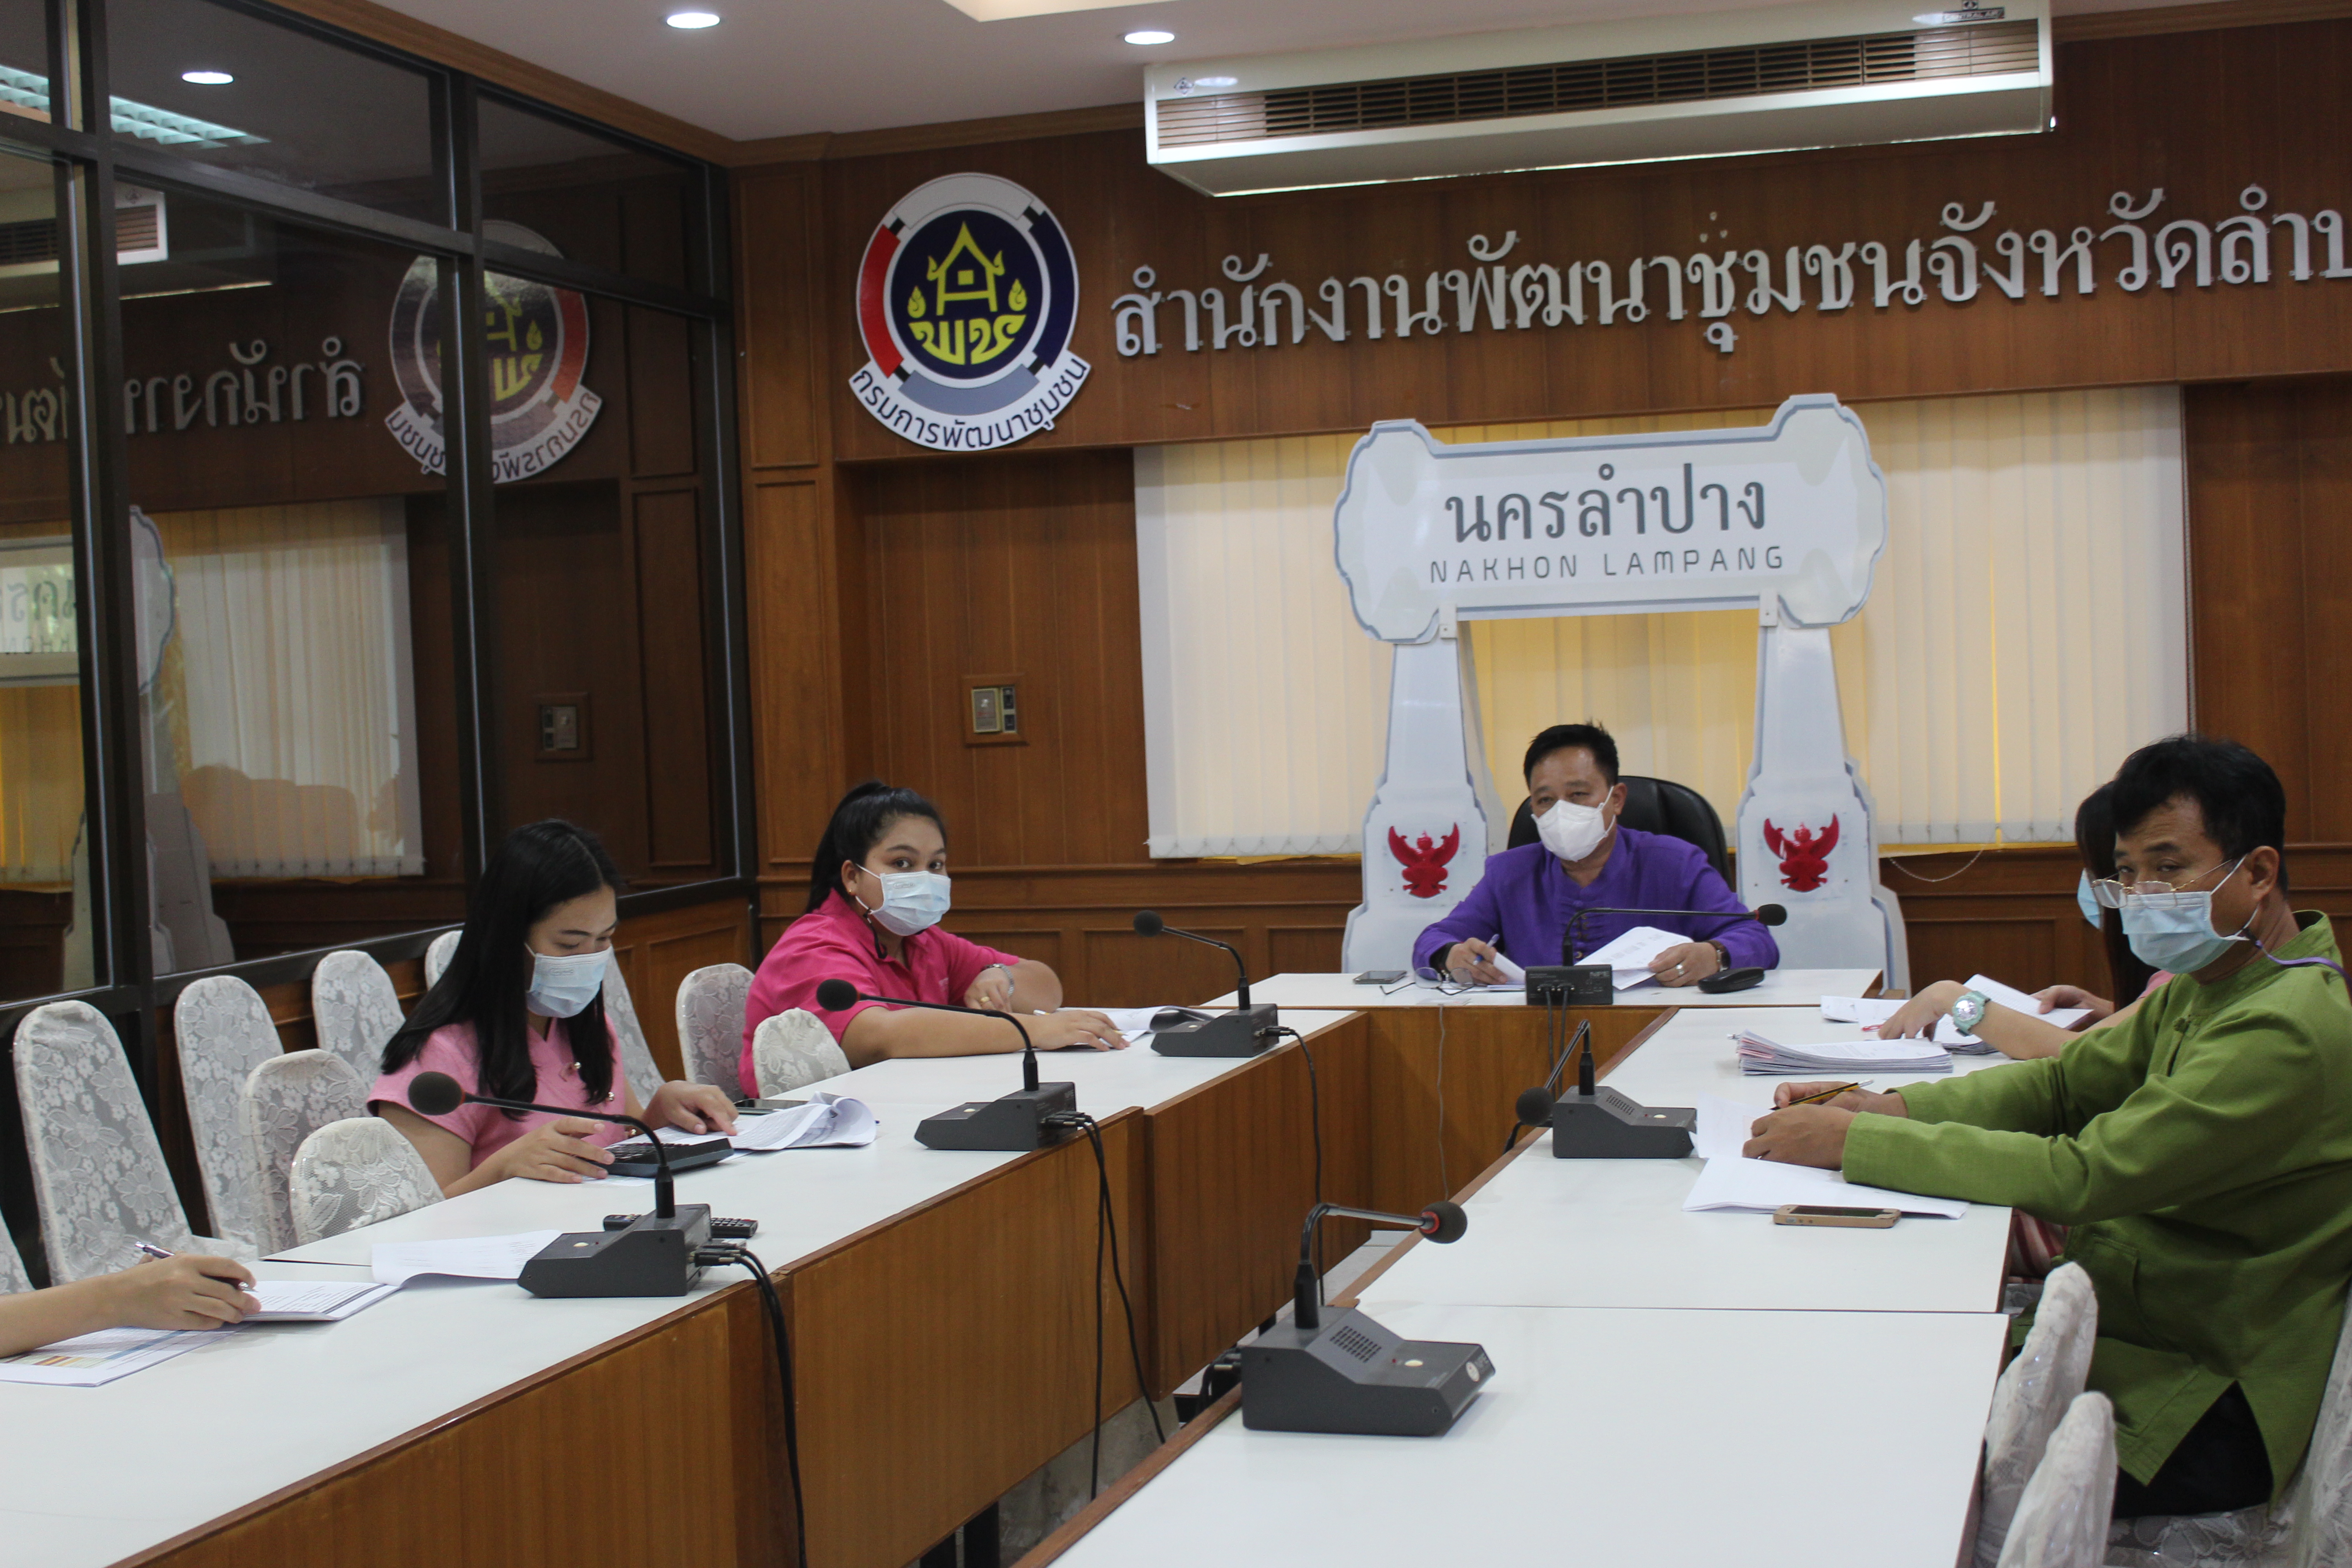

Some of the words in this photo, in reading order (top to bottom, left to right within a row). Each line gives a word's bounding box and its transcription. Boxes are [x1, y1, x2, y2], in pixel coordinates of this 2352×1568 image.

[853, 357, 1089, 448] กรมการพัฒนาชุมชน
[1445, 463, 1766, 543] นครลำปาง
[1431, 554, 1578, 583] NAKHON
[1604, 546, 1784, 576] LAMPANG
